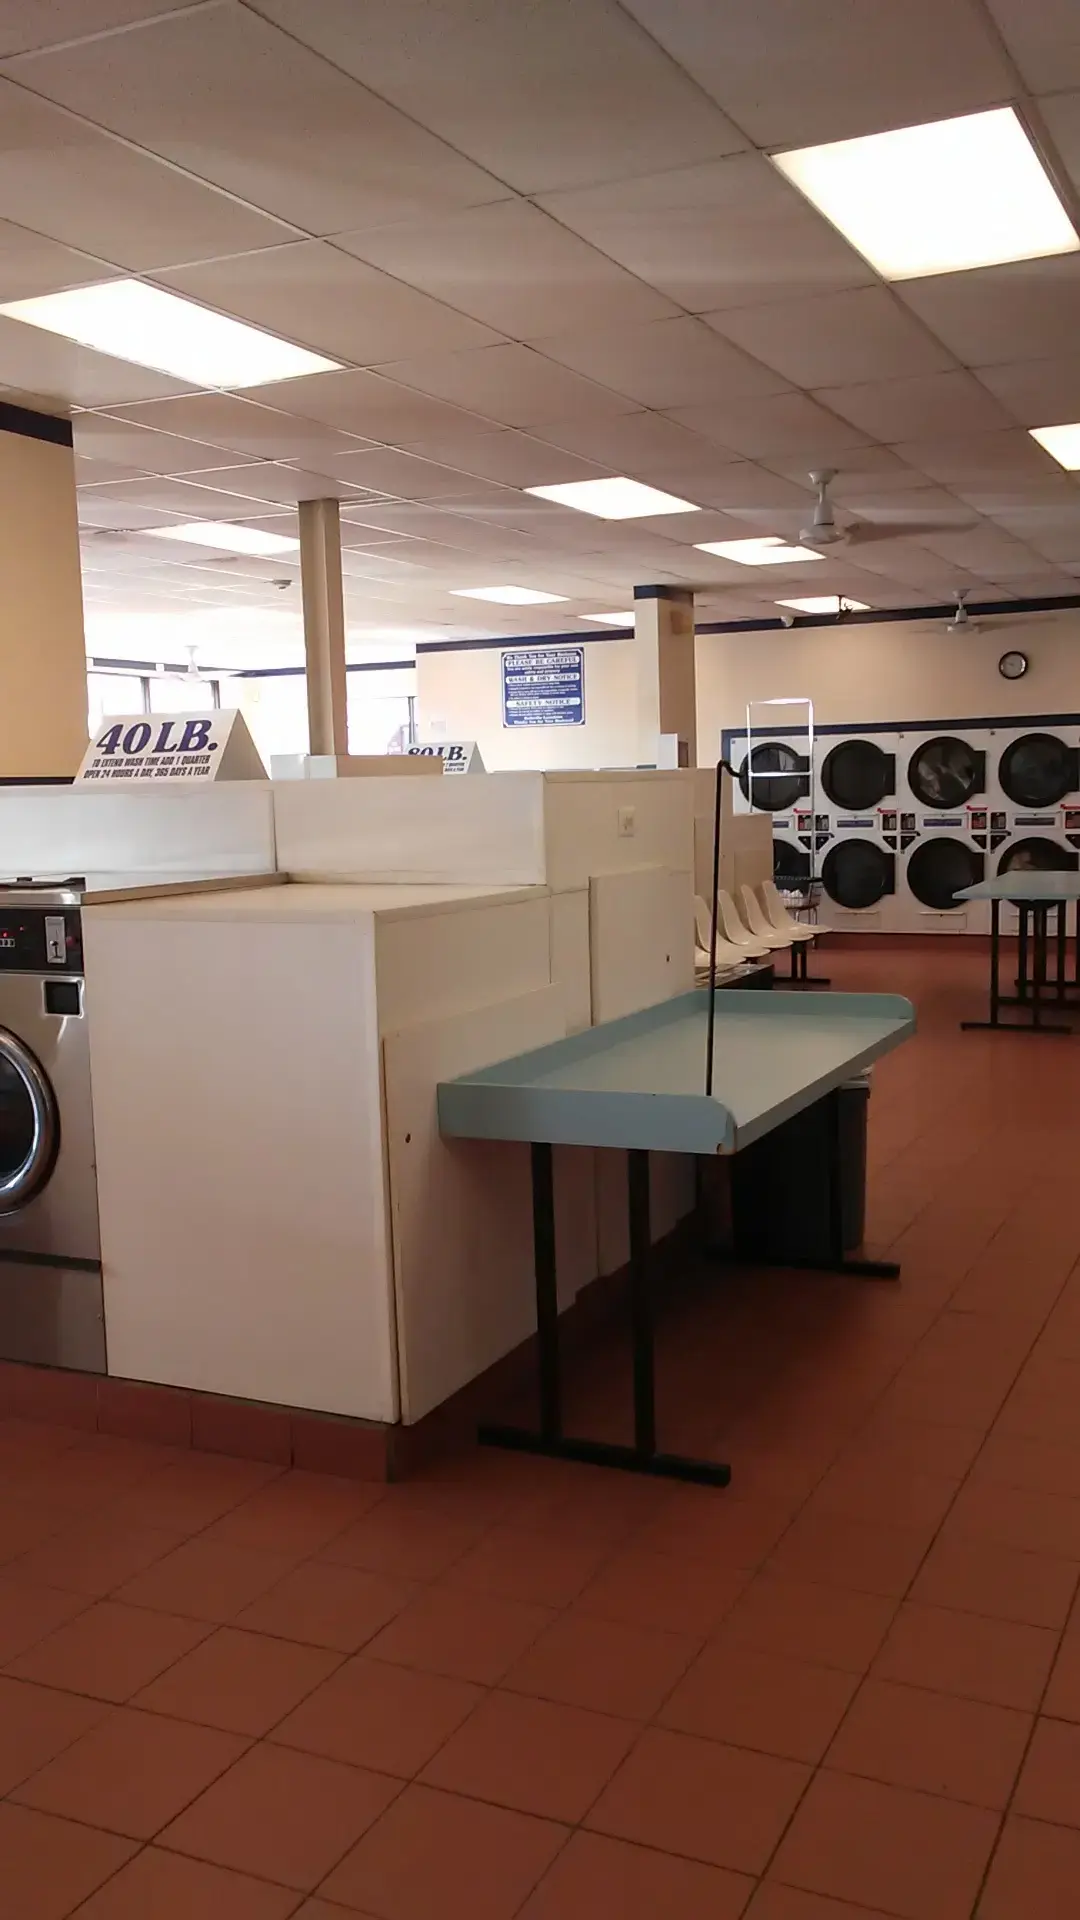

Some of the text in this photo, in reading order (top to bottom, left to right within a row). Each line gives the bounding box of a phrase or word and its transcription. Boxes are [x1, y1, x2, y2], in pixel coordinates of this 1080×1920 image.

[96, 720, 218, 755] 40 LB.
[438, 746, 468, 761] LB.
[92, 755, 211, 768] TO EXTEND WASH TIME ADD 1 QUARTER
[84, 766, 211, 778] OPEN 24 HOURS A DAY, 365 DAYS A YEAR
